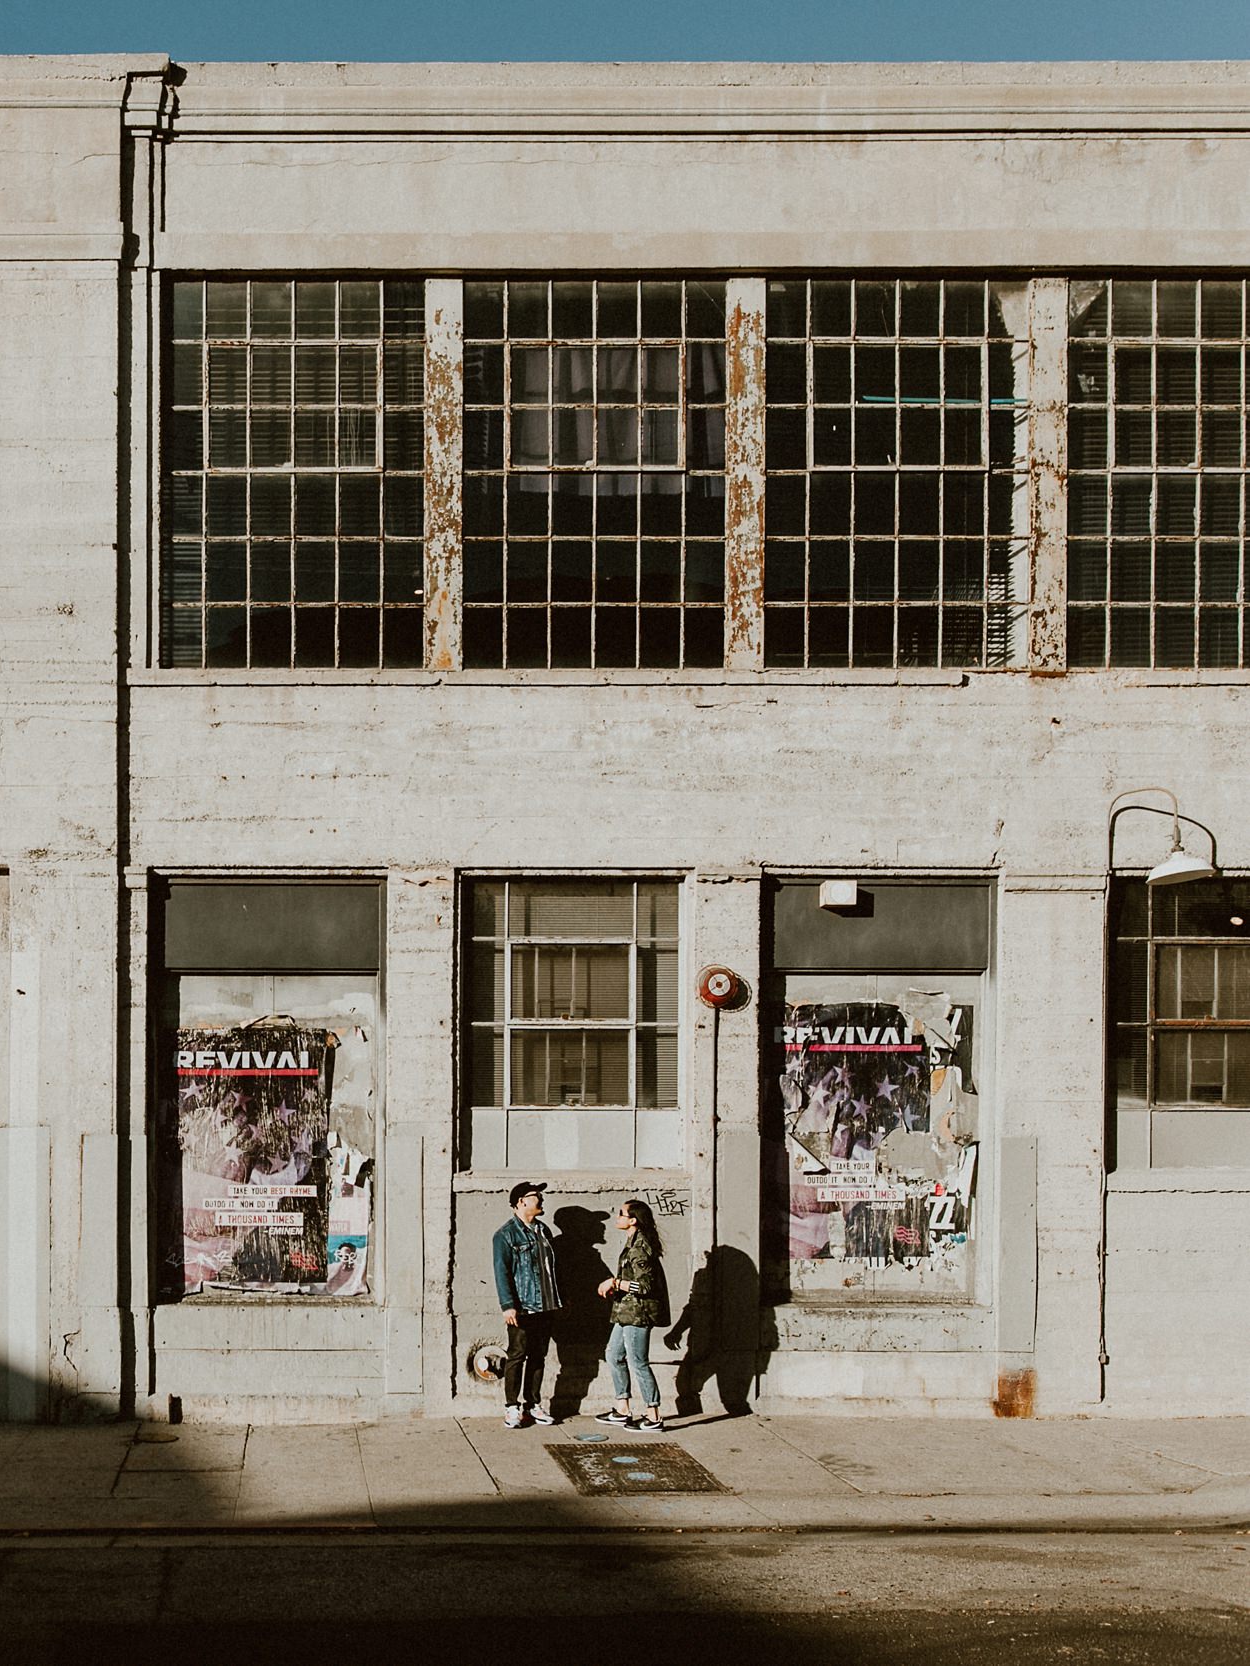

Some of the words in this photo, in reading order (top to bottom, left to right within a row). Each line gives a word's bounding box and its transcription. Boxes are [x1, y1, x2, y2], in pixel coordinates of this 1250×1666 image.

[836, 1162, 850, 1170] TAKE
[853, 1162, 870, 1170] YOUR
[807, 1176, 828, 1184] OUTDO
[843, 1176, 856, 1184] NOW
[858, 1176, 868, 1184] DO
[233, 1187, 248, 1195] TAKE
[251, 1187, 268, 1195] YOUR
[270, 1187, 286, 1195] BEST
[289, 1187, 311, 1195] RHYME
[820, 1190, 826, 1200] A
[830, 1190, 870, 1200] THOUSAND
[874, 1190, 897, 1200] TIMES
[205, 1200, 226, 1208] OUTDO
[240, 1200, 254, 1208] NOW
[257, 1200, 266, 1208] DO
[228, 1215, 268, 1224] THOUSAND
